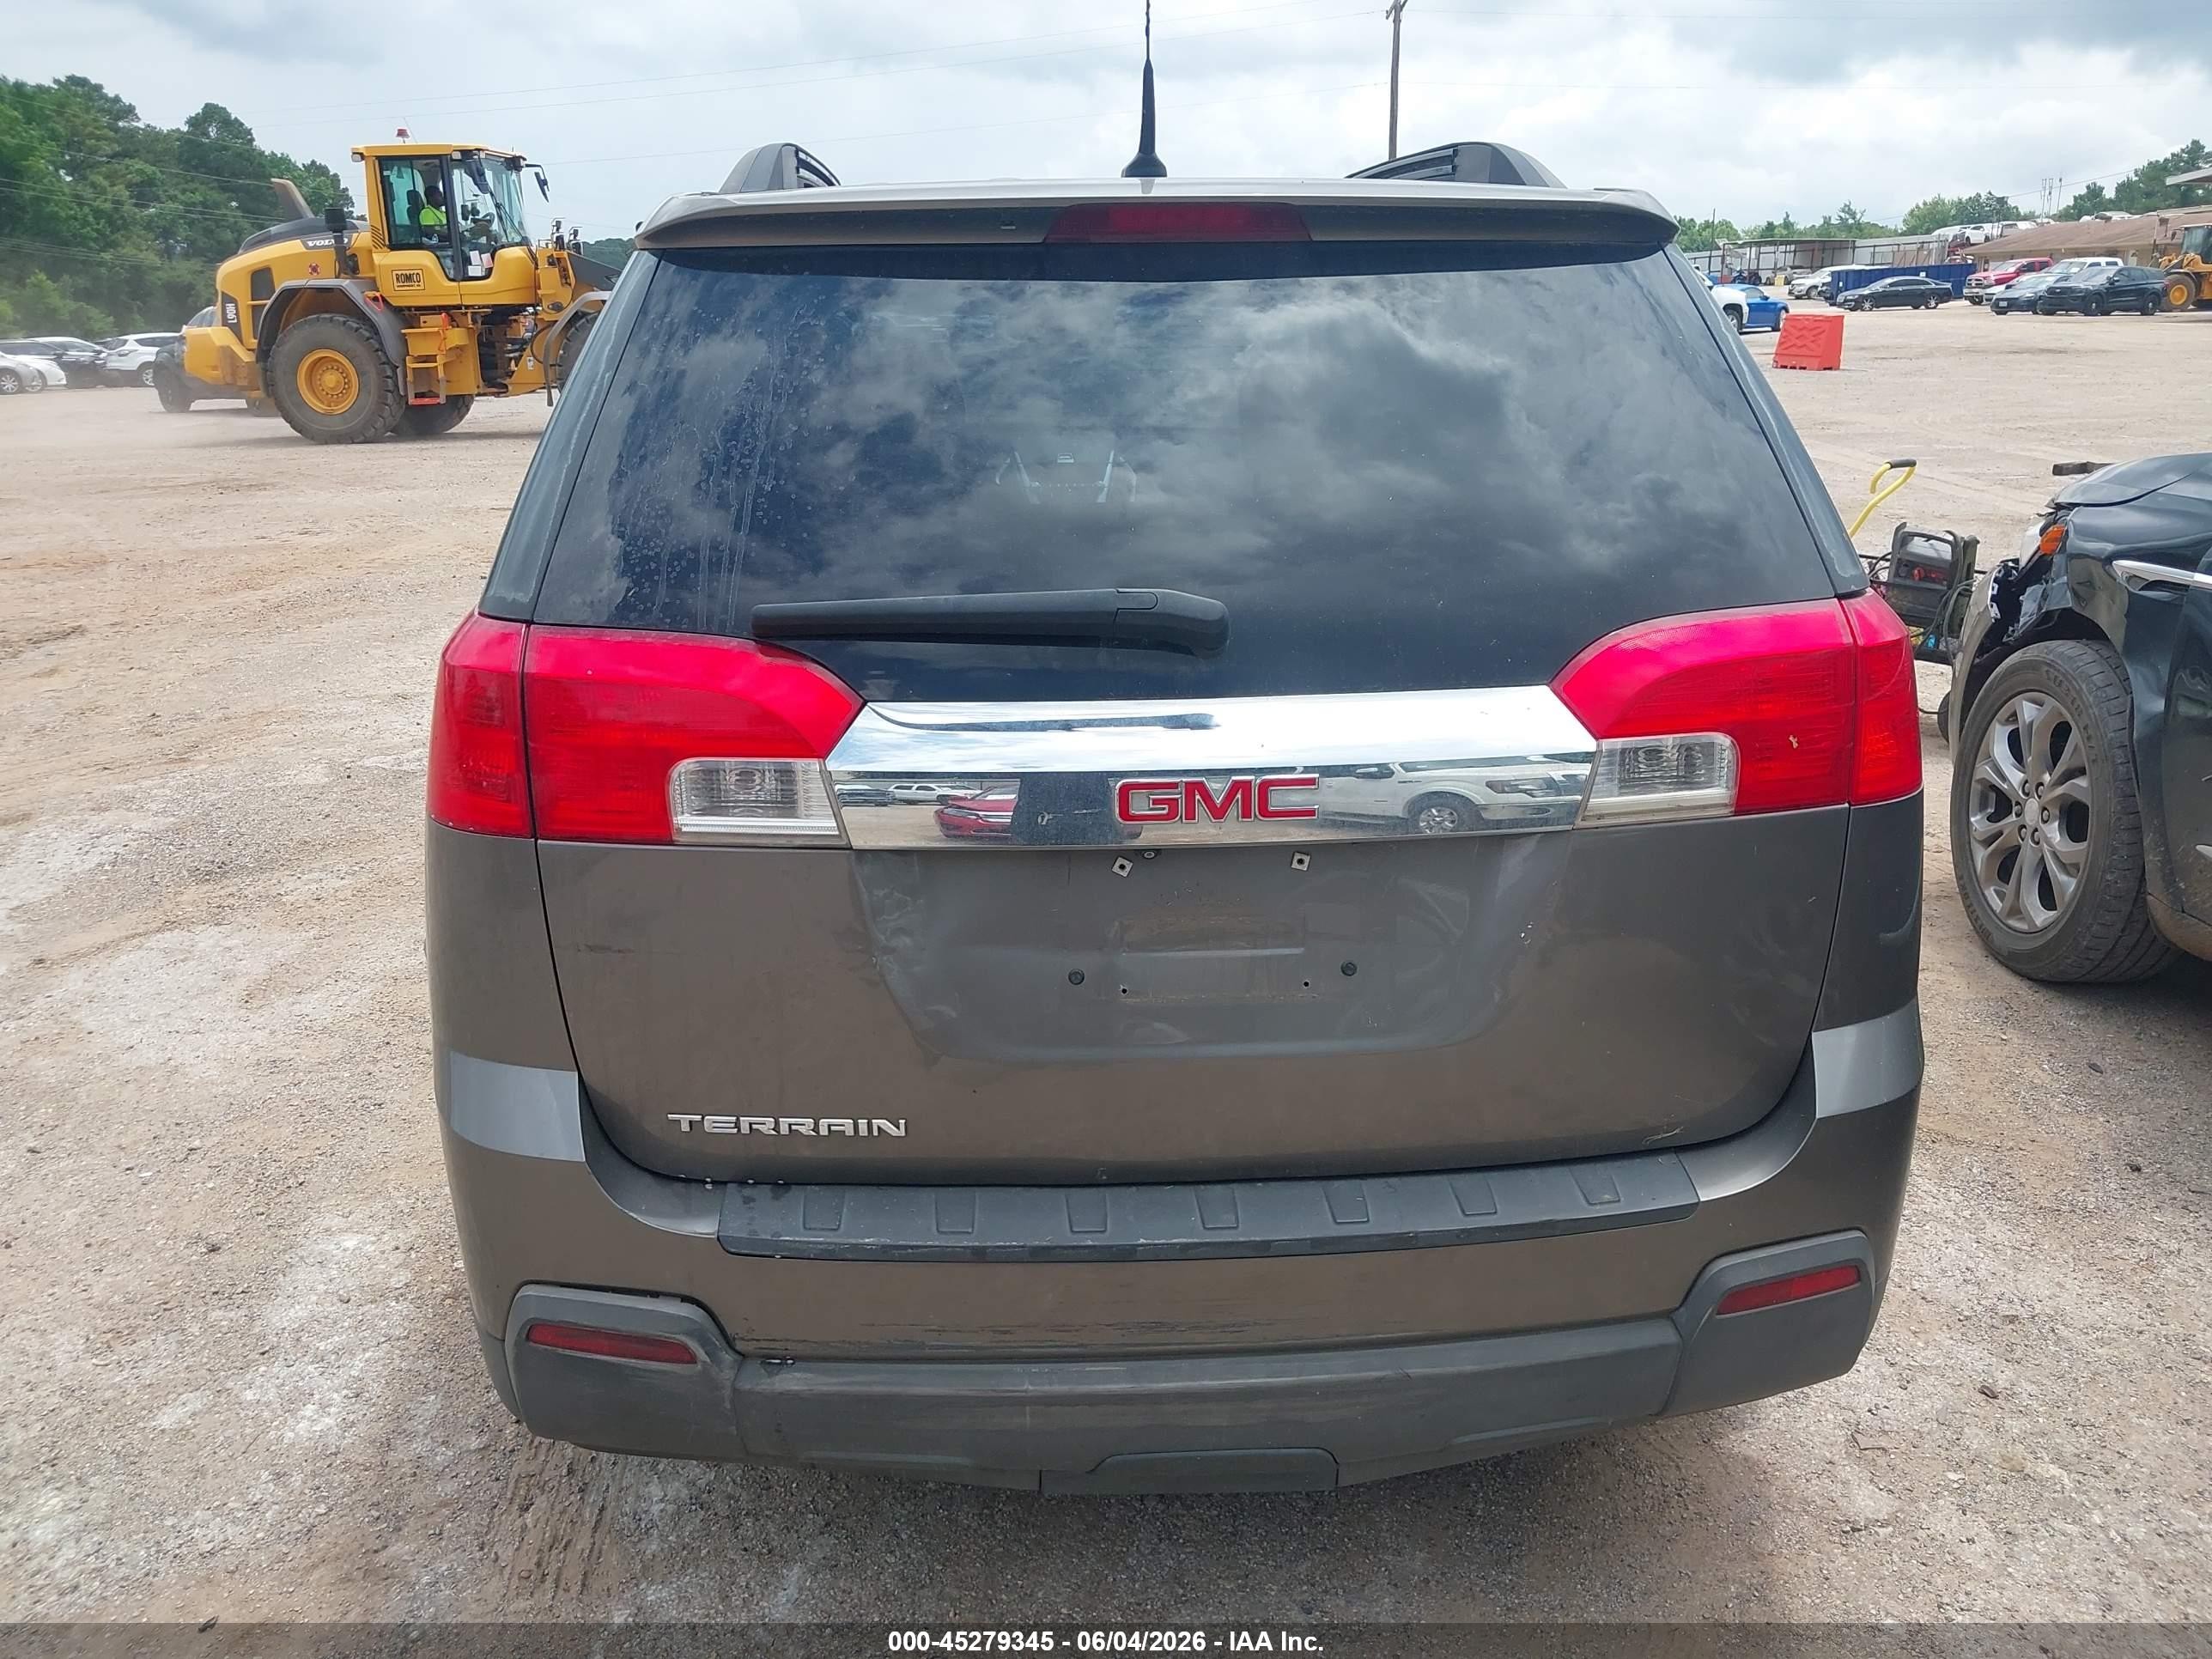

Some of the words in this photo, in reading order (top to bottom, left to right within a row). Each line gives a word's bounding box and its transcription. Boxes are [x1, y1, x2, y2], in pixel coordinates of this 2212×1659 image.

[395, 272, 421, 283] ROMCO
[225, 303, 237, 324] L90H
[1115, 774, 1319, 824] GMC
[667, 1114, 906, 1137] TERRAIN
